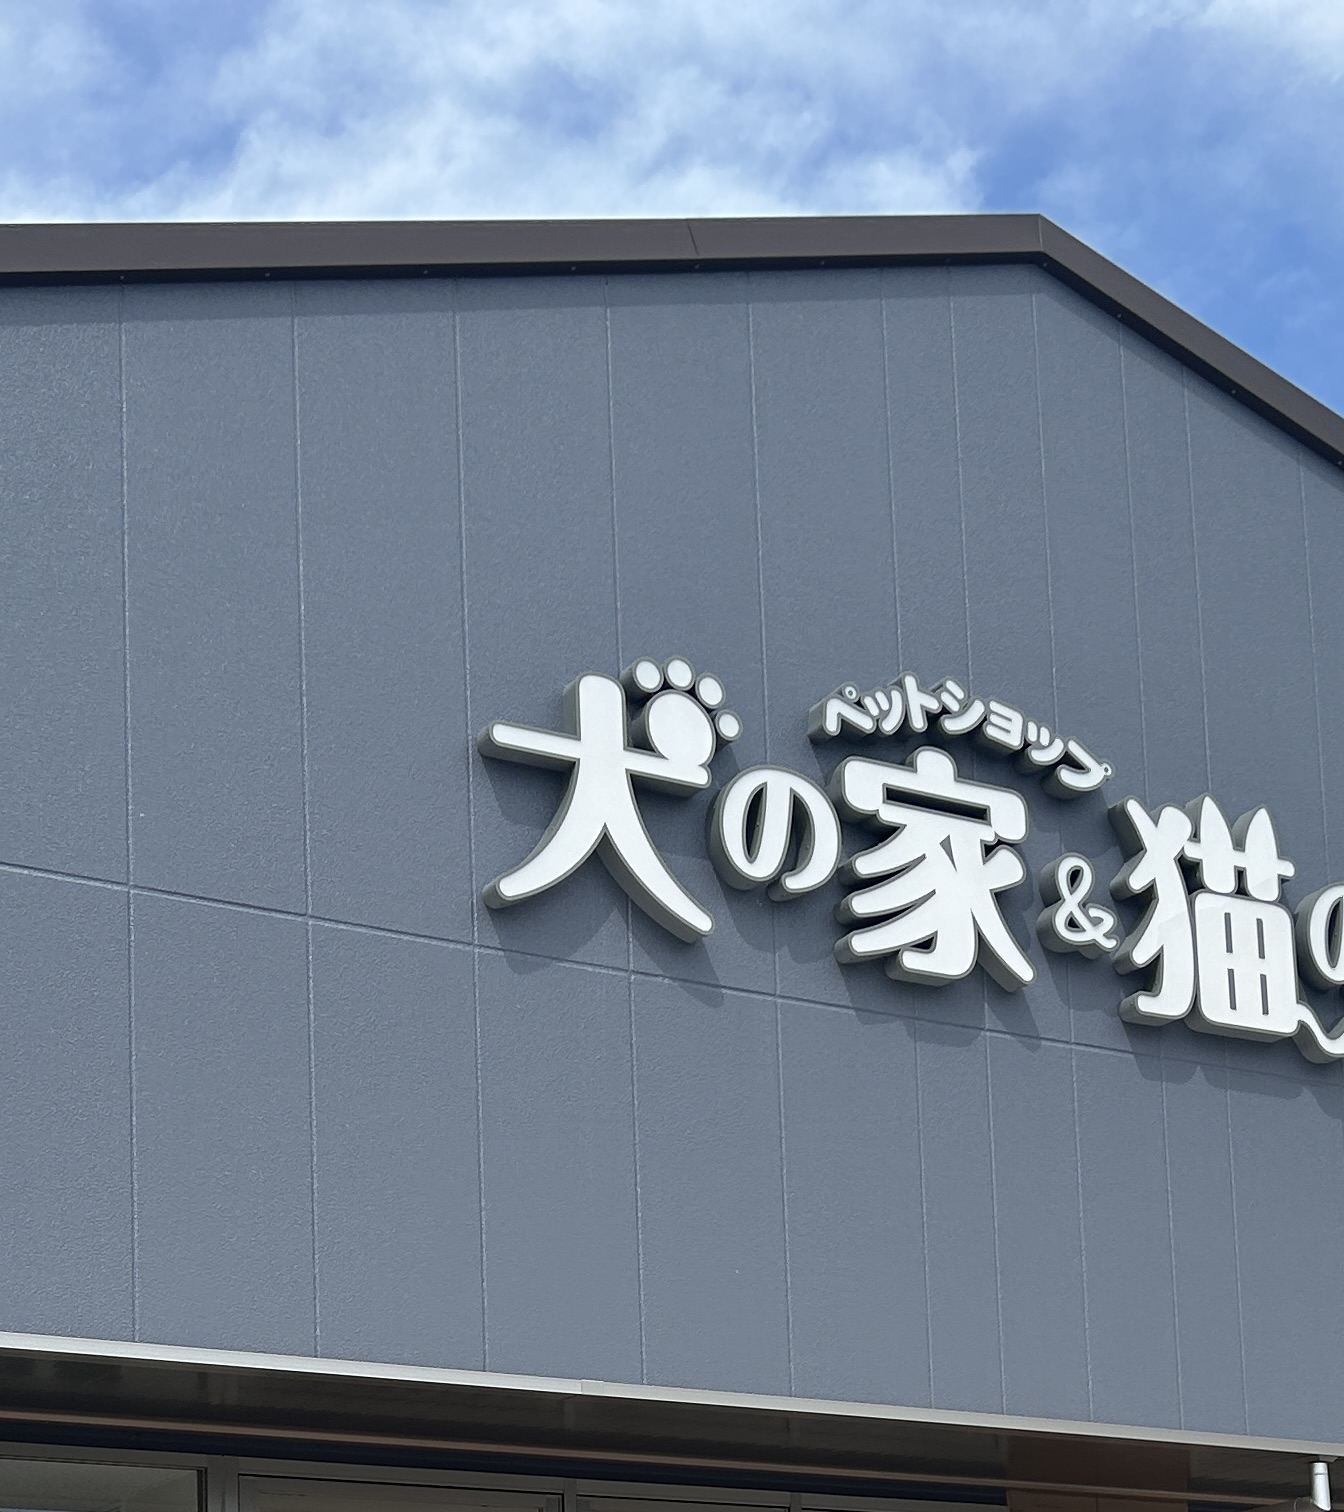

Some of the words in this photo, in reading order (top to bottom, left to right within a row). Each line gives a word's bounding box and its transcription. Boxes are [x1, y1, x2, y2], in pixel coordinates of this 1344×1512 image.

[818, 670, 1115, 793] ペットショップ
